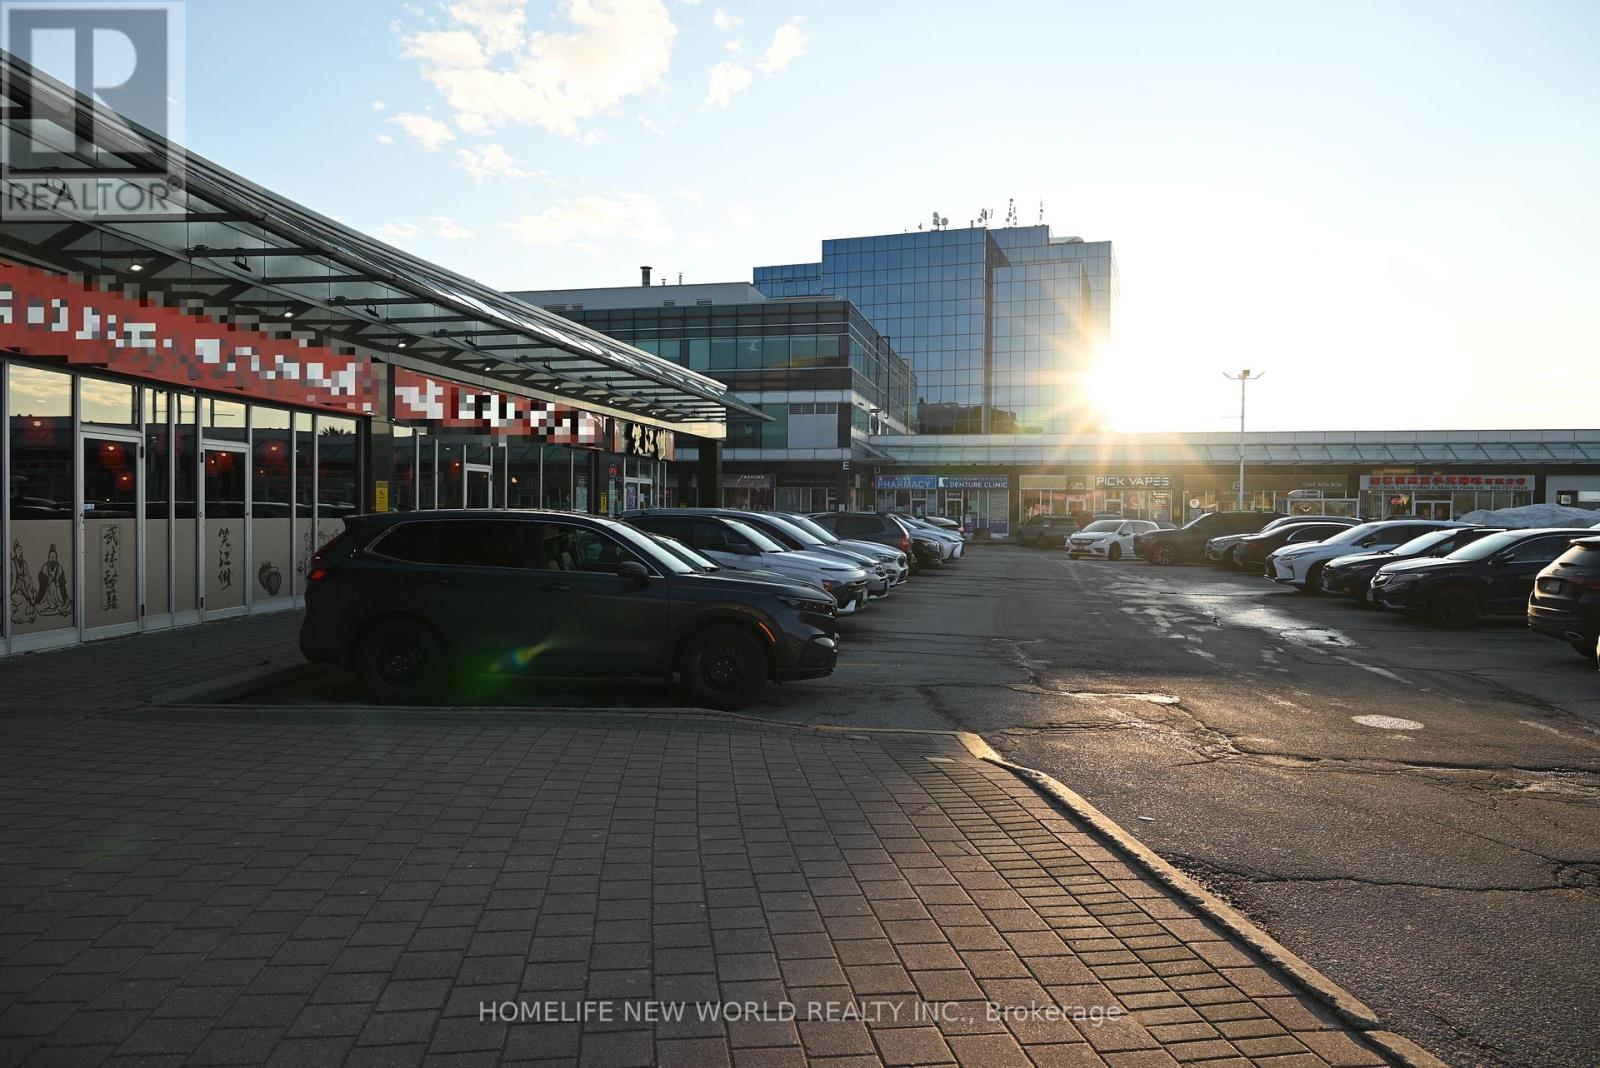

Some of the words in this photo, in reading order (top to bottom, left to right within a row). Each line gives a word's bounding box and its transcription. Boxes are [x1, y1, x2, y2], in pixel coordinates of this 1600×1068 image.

[878, 480, 931, 489] PHARMACY
[1096, 477, 1125, 486] PICK
[1128, 477, 1170, 486] VAPES
